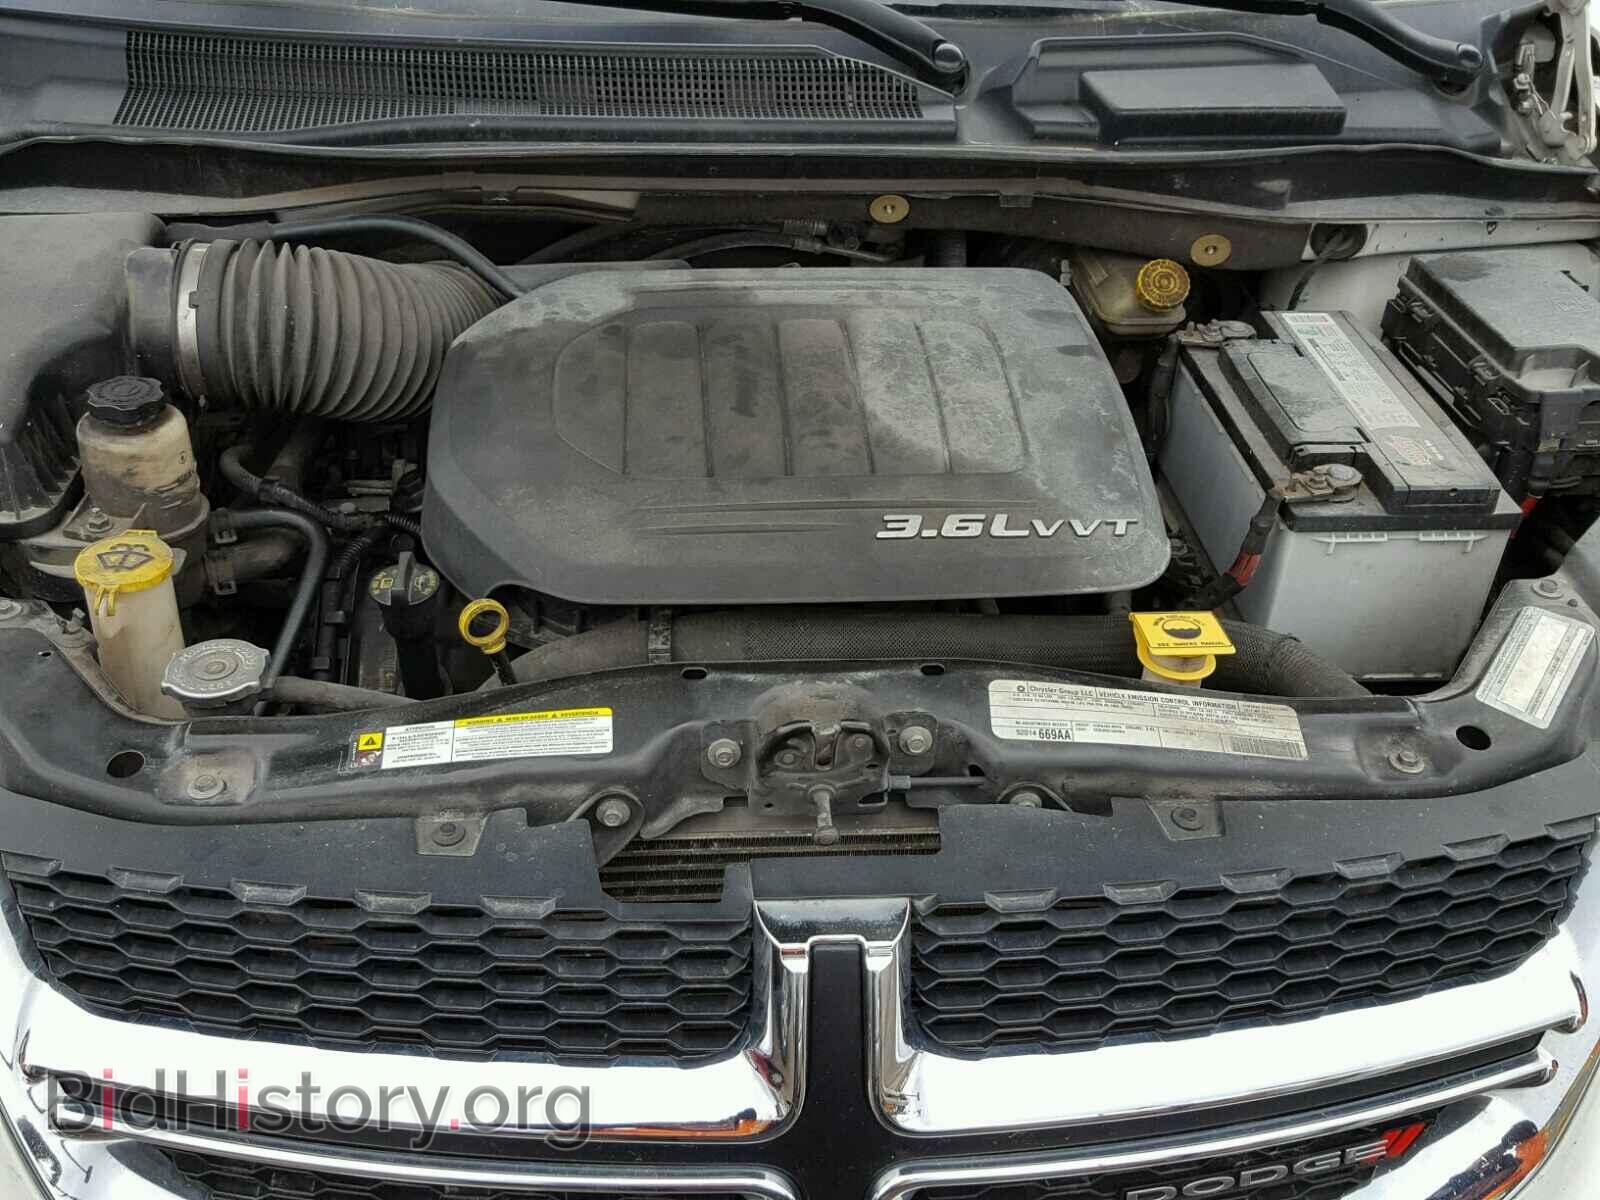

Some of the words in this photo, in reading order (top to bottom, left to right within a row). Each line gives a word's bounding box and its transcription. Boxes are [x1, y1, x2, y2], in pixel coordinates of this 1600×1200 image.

[1058, 688, 1079, 696] Group
[1099, 692, 1126, 700] VEHICLE
[1127, 693, 1159, 702] EMISSION
[1160, 696, 1190, 706] CONTROL
[1192, 699, 1236, 709] INFORMATION
[1038, 728, 1071, 740] 669AA
[1126, 1139, 1390, 1200] DODGE
